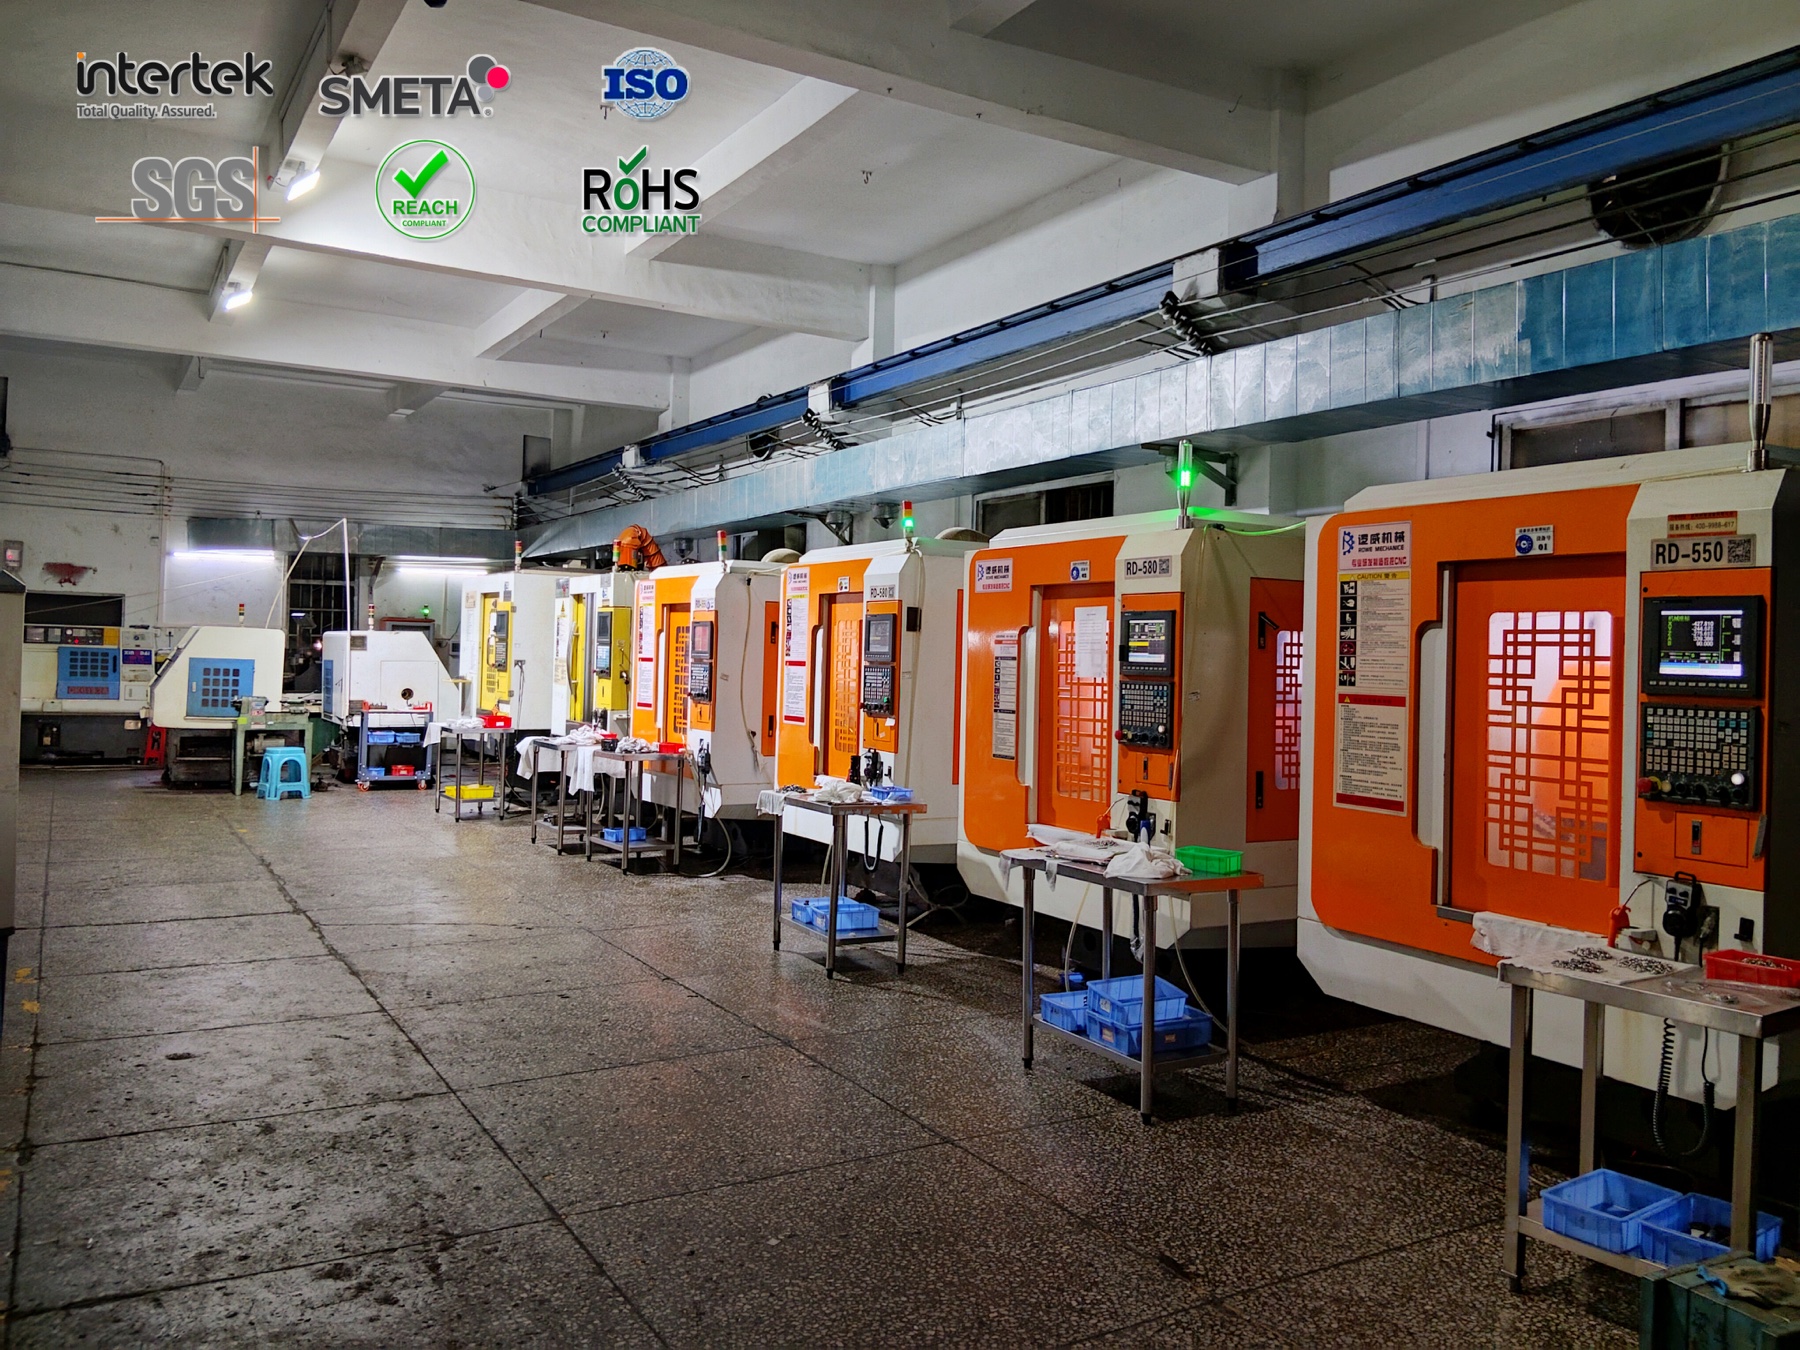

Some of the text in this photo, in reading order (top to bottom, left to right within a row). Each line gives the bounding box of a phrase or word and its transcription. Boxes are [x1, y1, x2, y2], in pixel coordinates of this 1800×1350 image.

[1538, 543, 1548, 551] 01
[1655, 541, 1723, 564] RD-550
[1126, 560, 1158, 575] RD-580
[870, 587, 887, 598] RD-580
